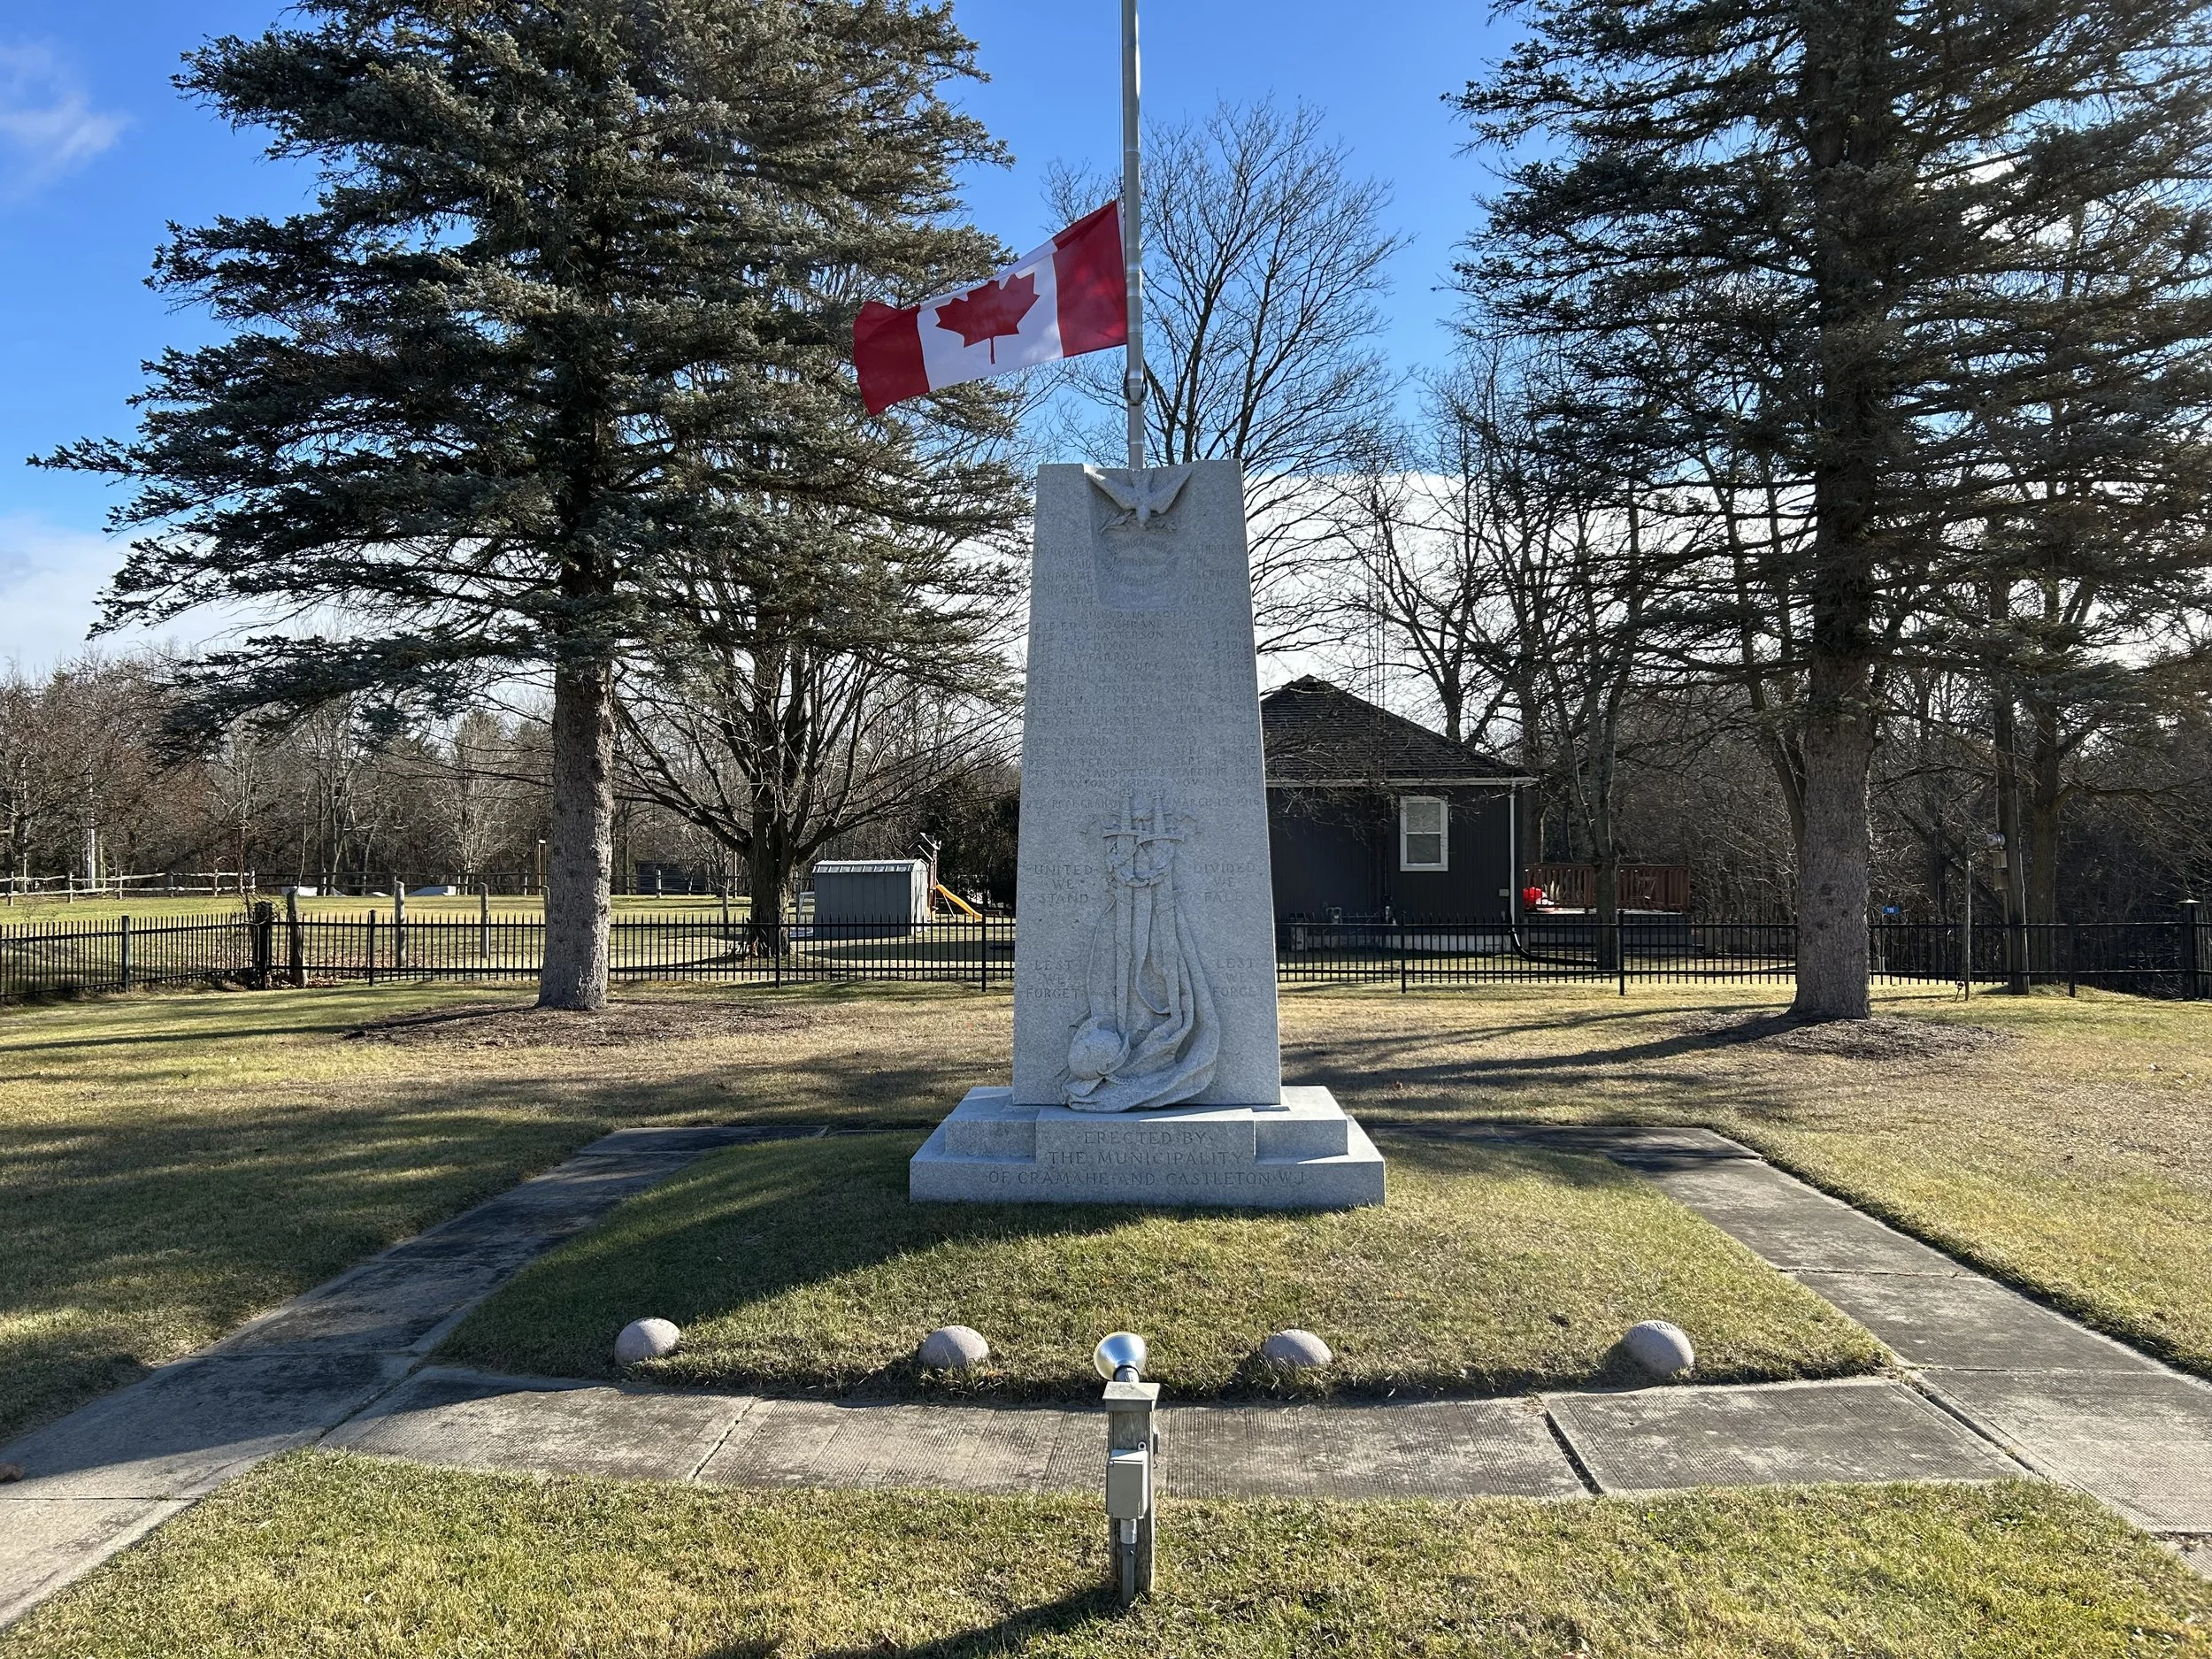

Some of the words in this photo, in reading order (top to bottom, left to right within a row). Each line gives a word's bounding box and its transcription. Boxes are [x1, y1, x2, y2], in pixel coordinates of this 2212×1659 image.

[1034, 864, 1093, 875] UNITED
[1194, 863, 1255, 873] DIVIDED
[1051, 879, 1074, 889] WE
[1214, 877, 1235, 887] WE
[1038, 893, 1088, 904] STAND
[1204, 892, 1244, 902] FALL
[1035, 960, 1073, 971] LEST
[1217, 957, 1255, 969] LEST
[1026, 987, 1079, 999] FORGET
[1212, 986, 1264, 997] FORGET
[1085, 1131, 1171, 1145] ERECTED
[1182, 1131, 1207, 1144] BY
[1048, 1151, 1087, 1164] THE
[1098, 1151, 1242, 1165] MUNICIPALITY
[988, 1171, 1010, 1184] OF
[1018, 1171, 1108, 1185] CRAMAHE
[1118, 1171, 1155, 1186] AND
[1165, 1171, 1270, 1186] CASTLETON
